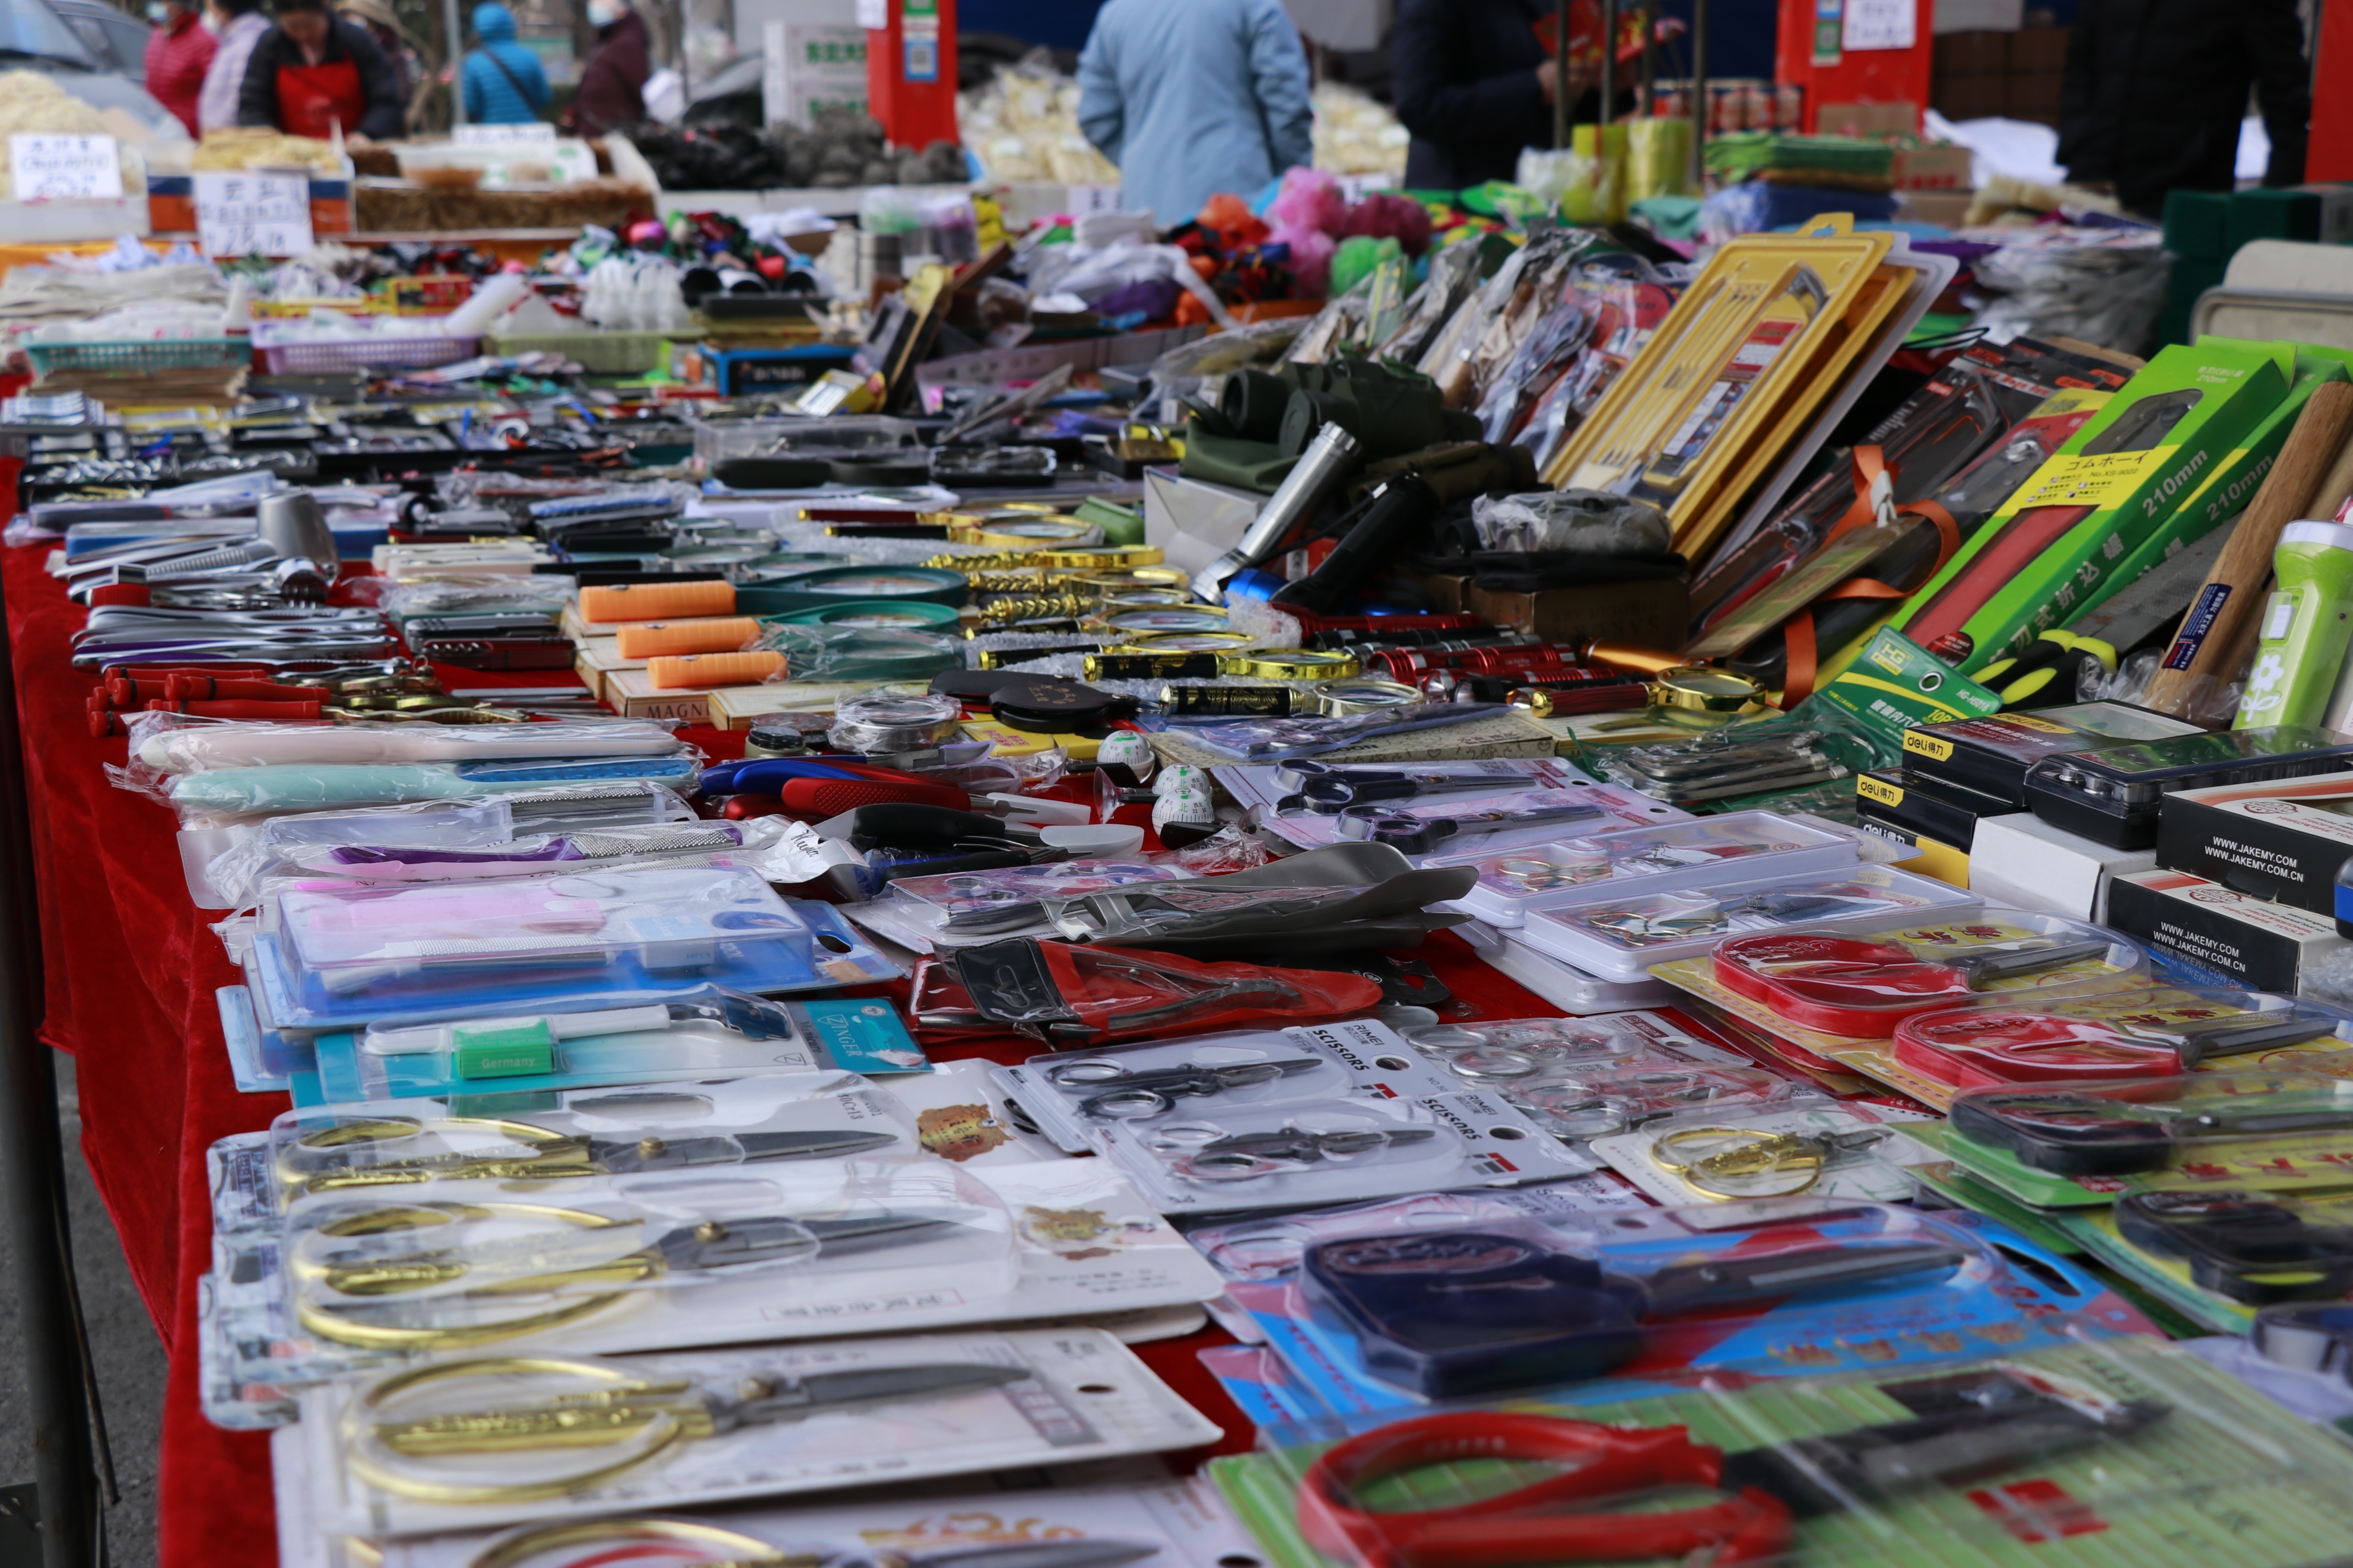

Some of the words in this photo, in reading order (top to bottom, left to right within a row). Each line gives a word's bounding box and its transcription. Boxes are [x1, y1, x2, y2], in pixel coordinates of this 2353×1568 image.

[2142, 449, 2209, 518] 210mm
[2205, 454, 2273, 521] 210mm
[1881, 643, 1907, 664] HG
[1179, 803, 1188, 813] 北
[2276, 816, 2334, 833] HARDWARE
[2205, 845, 2304, 883] WWW.JAKEMY.COM.CN
[2212, 835, 2297, 869] WWW.JAKEMY.COM
[2219, 905, 2273, 924] HARDWARE
[2273, 923, 2307, 936] TOOLS
[2243, 908, 2314, 934] PROFESSIONAL
[2153, 930, 2246, 973] WWW.JAKEMY.COM.CN
[2161, 921, 2240, 958] WWW.JAKEMY.COM
[798, 1021, 823, 1054] Manicure
[826, 1016, 863, 1057] ZINGER
[1313, 1029, 1370, 1071] SCISSORS
[1352, 1024, 1385, 1046] RIMEI
[481, 1058, 535, 1069] Germany
[1422, 1098, 1483, 1140] SCISSORS
[1466, 1094, 1498, 1115] RIMEI
